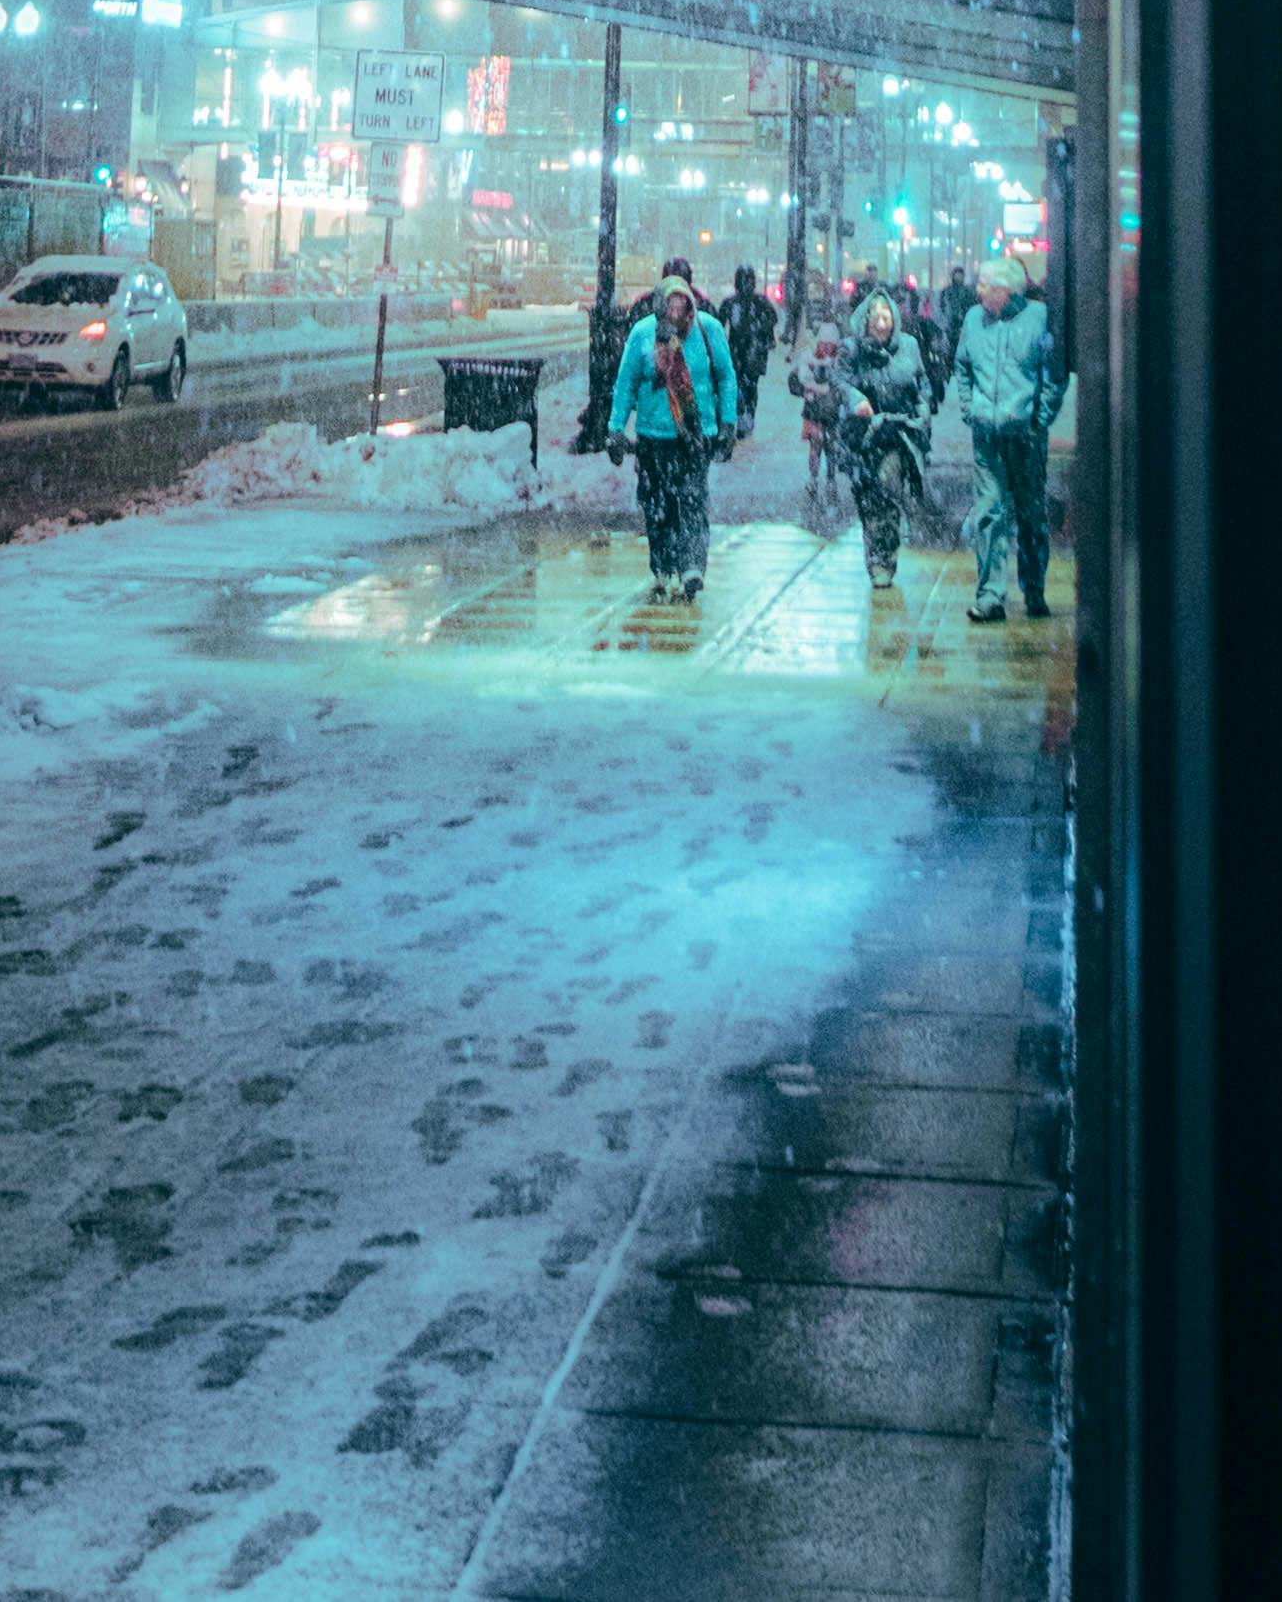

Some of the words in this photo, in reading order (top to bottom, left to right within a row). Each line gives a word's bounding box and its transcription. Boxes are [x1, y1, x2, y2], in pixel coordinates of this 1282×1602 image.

[363, 62, 393, 76] LEFT
[405, 64, 437, 80] LANE
[374, 88, 415, 106] MUST
[359, 113, 391, 128] TURN
[405, 115, 435, 131] LEFT
[381, 150, 399, 168] NO
